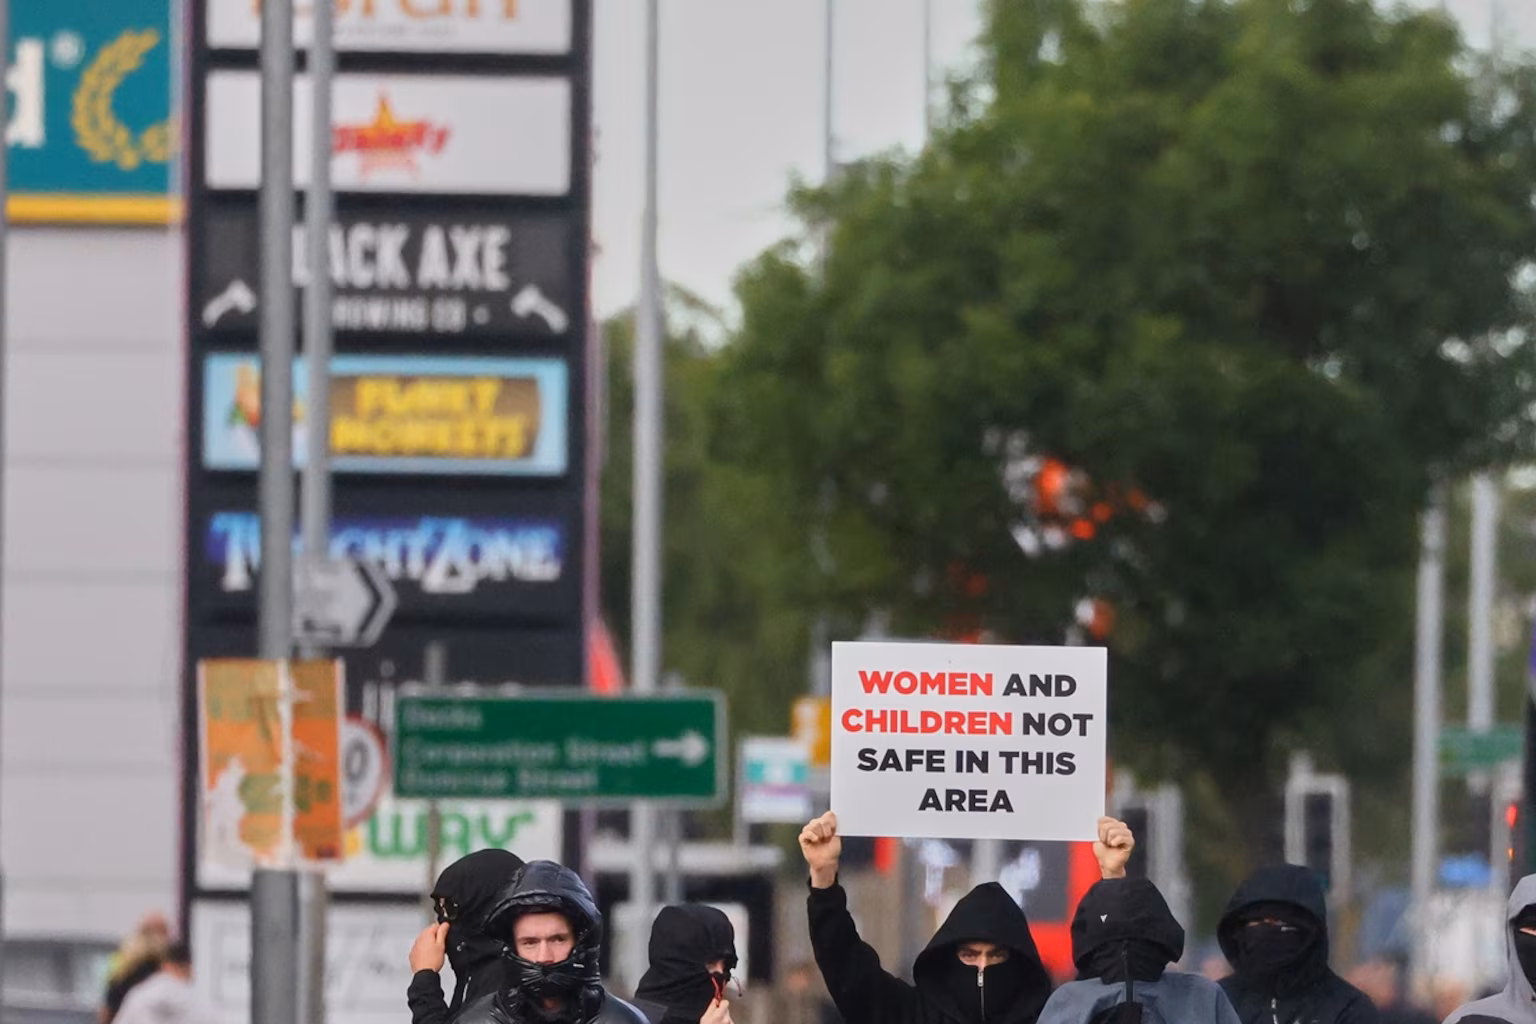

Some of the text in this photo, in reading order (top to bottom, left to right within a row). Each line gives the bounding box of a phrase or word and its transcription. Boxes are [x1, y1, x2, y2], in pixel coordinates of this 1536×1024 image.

[416, 225, 512, 291] AXE
[858, 671, 1077, 697] WOMEN AND
[841, 708, 1093, 737] CHILDREN NOT
[857, 748, 1077, 775] SAFE IN THIS
[918, 788, 1014, 813] AREA
